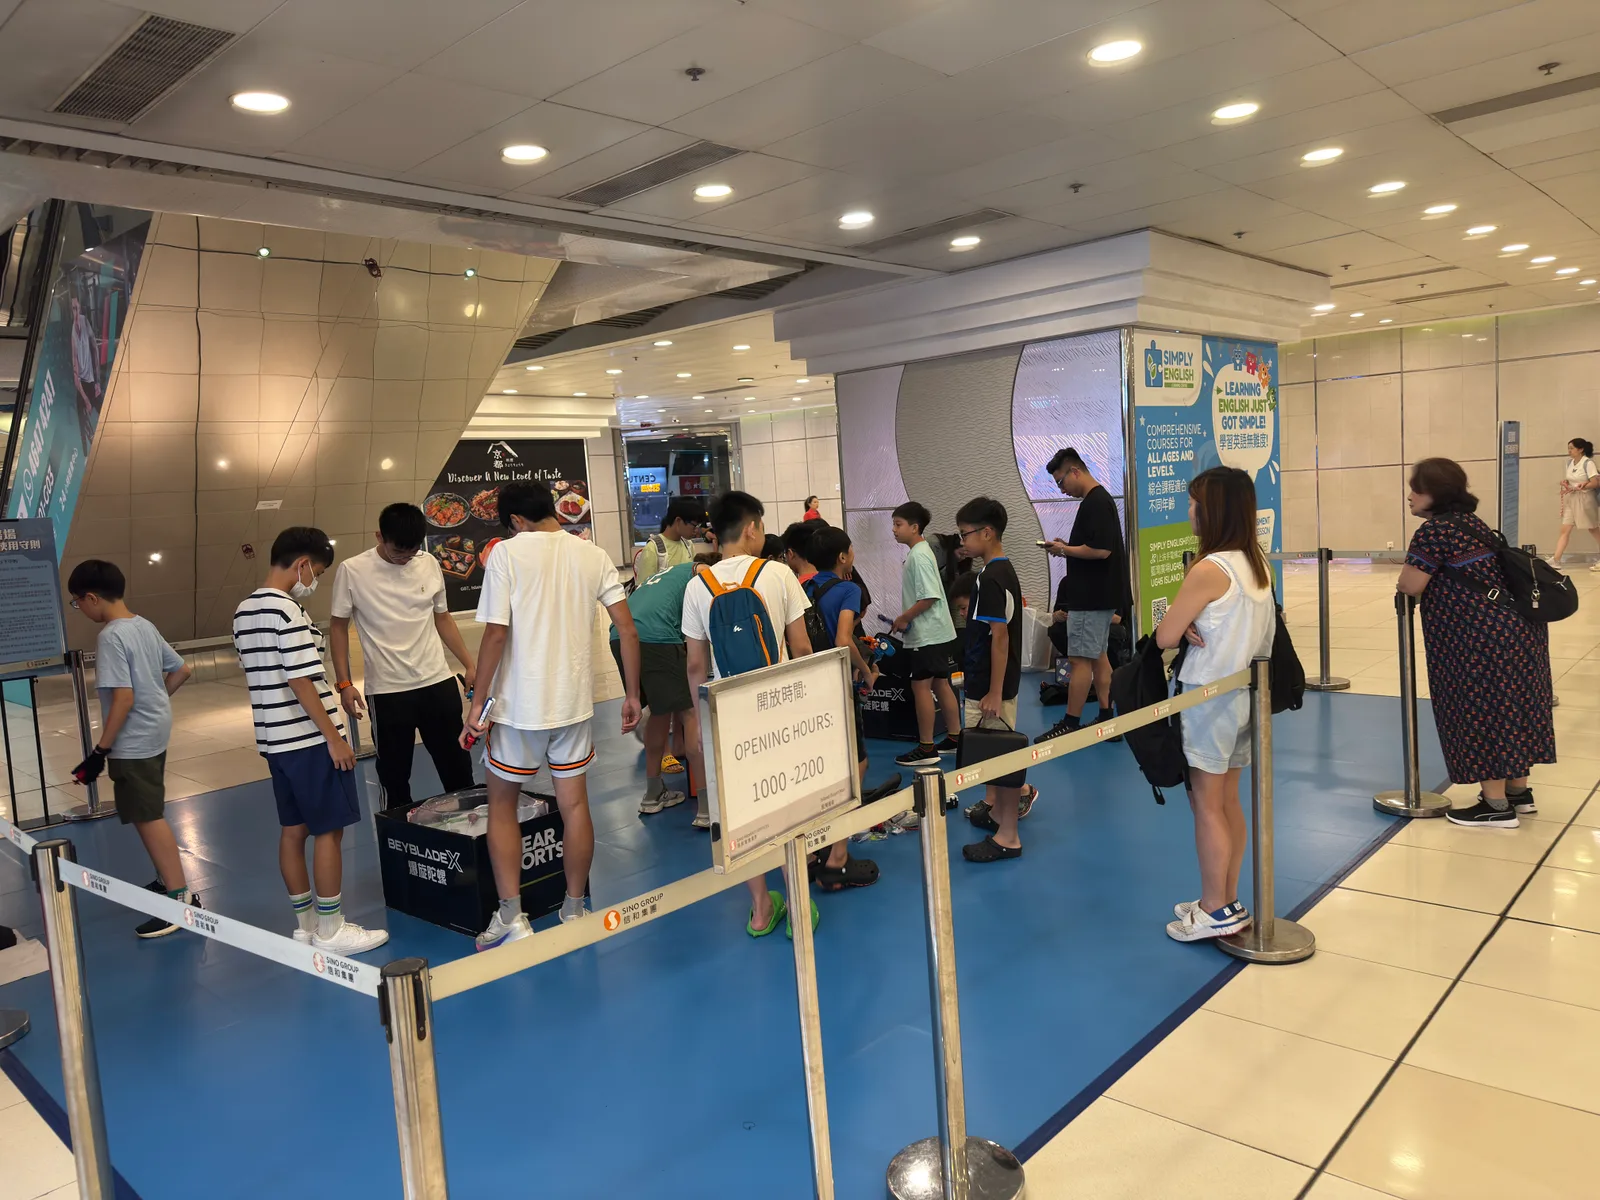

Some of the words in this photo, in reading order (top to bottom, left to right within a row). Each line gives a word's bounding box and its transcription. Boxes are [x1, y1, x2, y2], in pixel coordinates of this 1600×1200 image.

[1164, 350, 1193, 366] SIMPLY
[1164, 368, 1194, 381] ENGLISH
[1225, 382, 1261, 396] LEARNING
[1218, 399, 1250, 413] ENGLISH
[1251, 399, 1267, 413] JUST
[1146, 424, 1201, 436] COMPREHENSIVE
[1221, 416, 1237, 430] GOT
[1239, 415, 1266, 429] SIMPLE!
[1146, 438, 1178, 450] COURSES
[1180, 437, 1193, 448] FOR
[1147, 452, 1161, 464] ALL
[1162, 451, 1179, 462] AGES
[1181, 450, 1194, 461] AND
[448, 472, 482, 483] Discover
[485, 471, 491, 481] A
[494, 472, 510, 482] New
[512, 470, 531, 481] Level
[534, 469, 541, 482] of
[543, 468, 562, 480] Taste
[1147, 465, 1175, 478] LEVELS.
[1149, 497, 1176, 512] 不同年齡
[1150, 541, 1166, 551] SIMPLY
[757, 681, 807, 712] 開放時間:
[734, 727, 790, 761] OPENING
[793, 713, 834, 740] HOURS:
[753, 771, 787, 802] 1000
[521, 828, 556, 847] EAR
[521, 842, 564, 870] ORTS
[408, 860, 447, 886] 爆旋陀螺
[621, 902, 640, 915] SINO
[640, 892, 664, 907] GROUP
[193, 911, 204, 920] SINO
[204, 915, 219, 925] GROUP
[326, 956, 339, 967] SINO
[340, 961, 359, 973] GROUP
